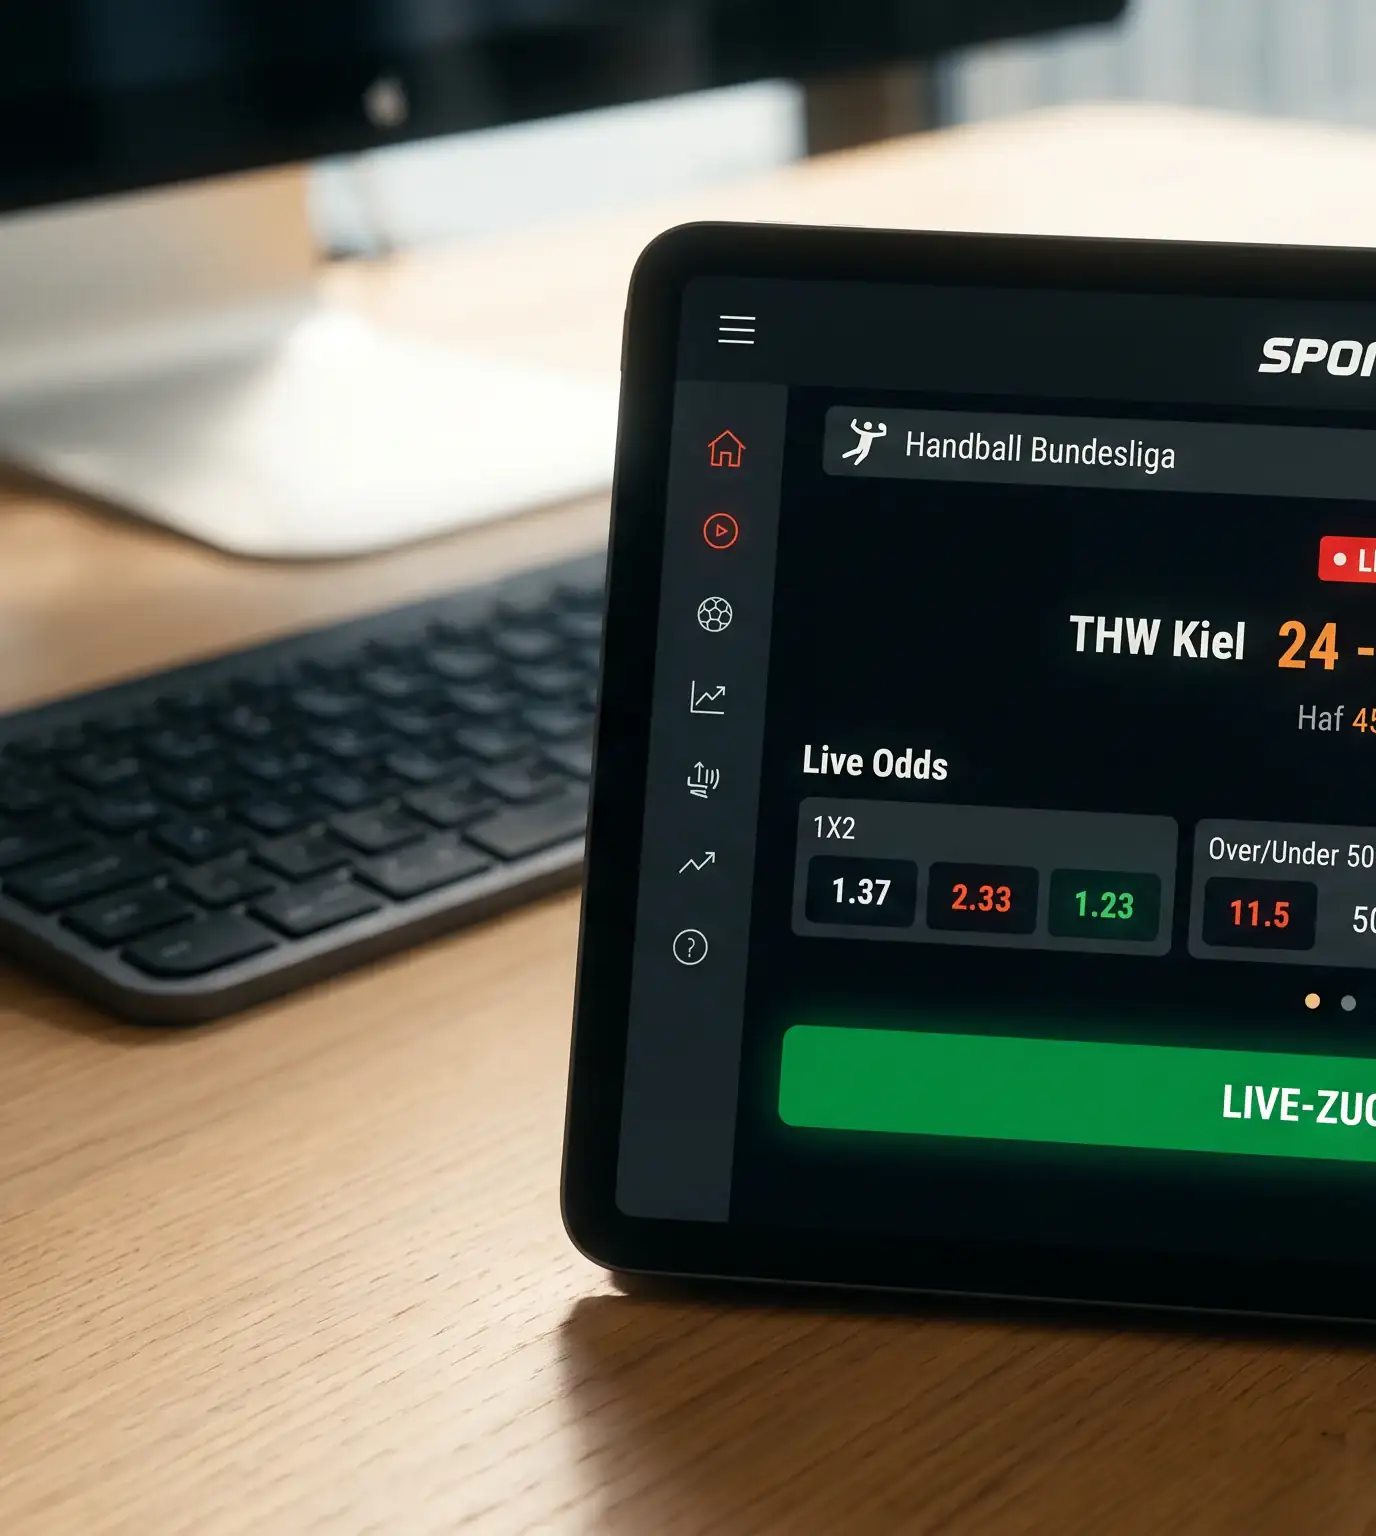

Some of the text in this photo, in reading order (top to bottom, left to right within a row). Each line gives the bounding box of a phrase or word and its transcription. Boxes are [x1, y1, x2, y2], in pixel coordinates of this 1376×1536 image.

[906, 430, 1175, 475] Handball Bundesliga
[1069, 614, 1162, 656] THW
[1173, 619, 1246, 660] Kiel
[1278, 620, 1339, 671] 24
[1298, 704, 1345, 732] Haf
[803, 744, 948, 781] Live Odds
[814, 815, 855, 840] 1X2
[1209, 836, 1340, 867] Over/Under
[833, 877, 891, 906] 1.37
[951, 883, 1011, 913] 2.33
[1075, 890, 1134, 920] 1.23
[1230, 899, 1290, 928] 11.5
